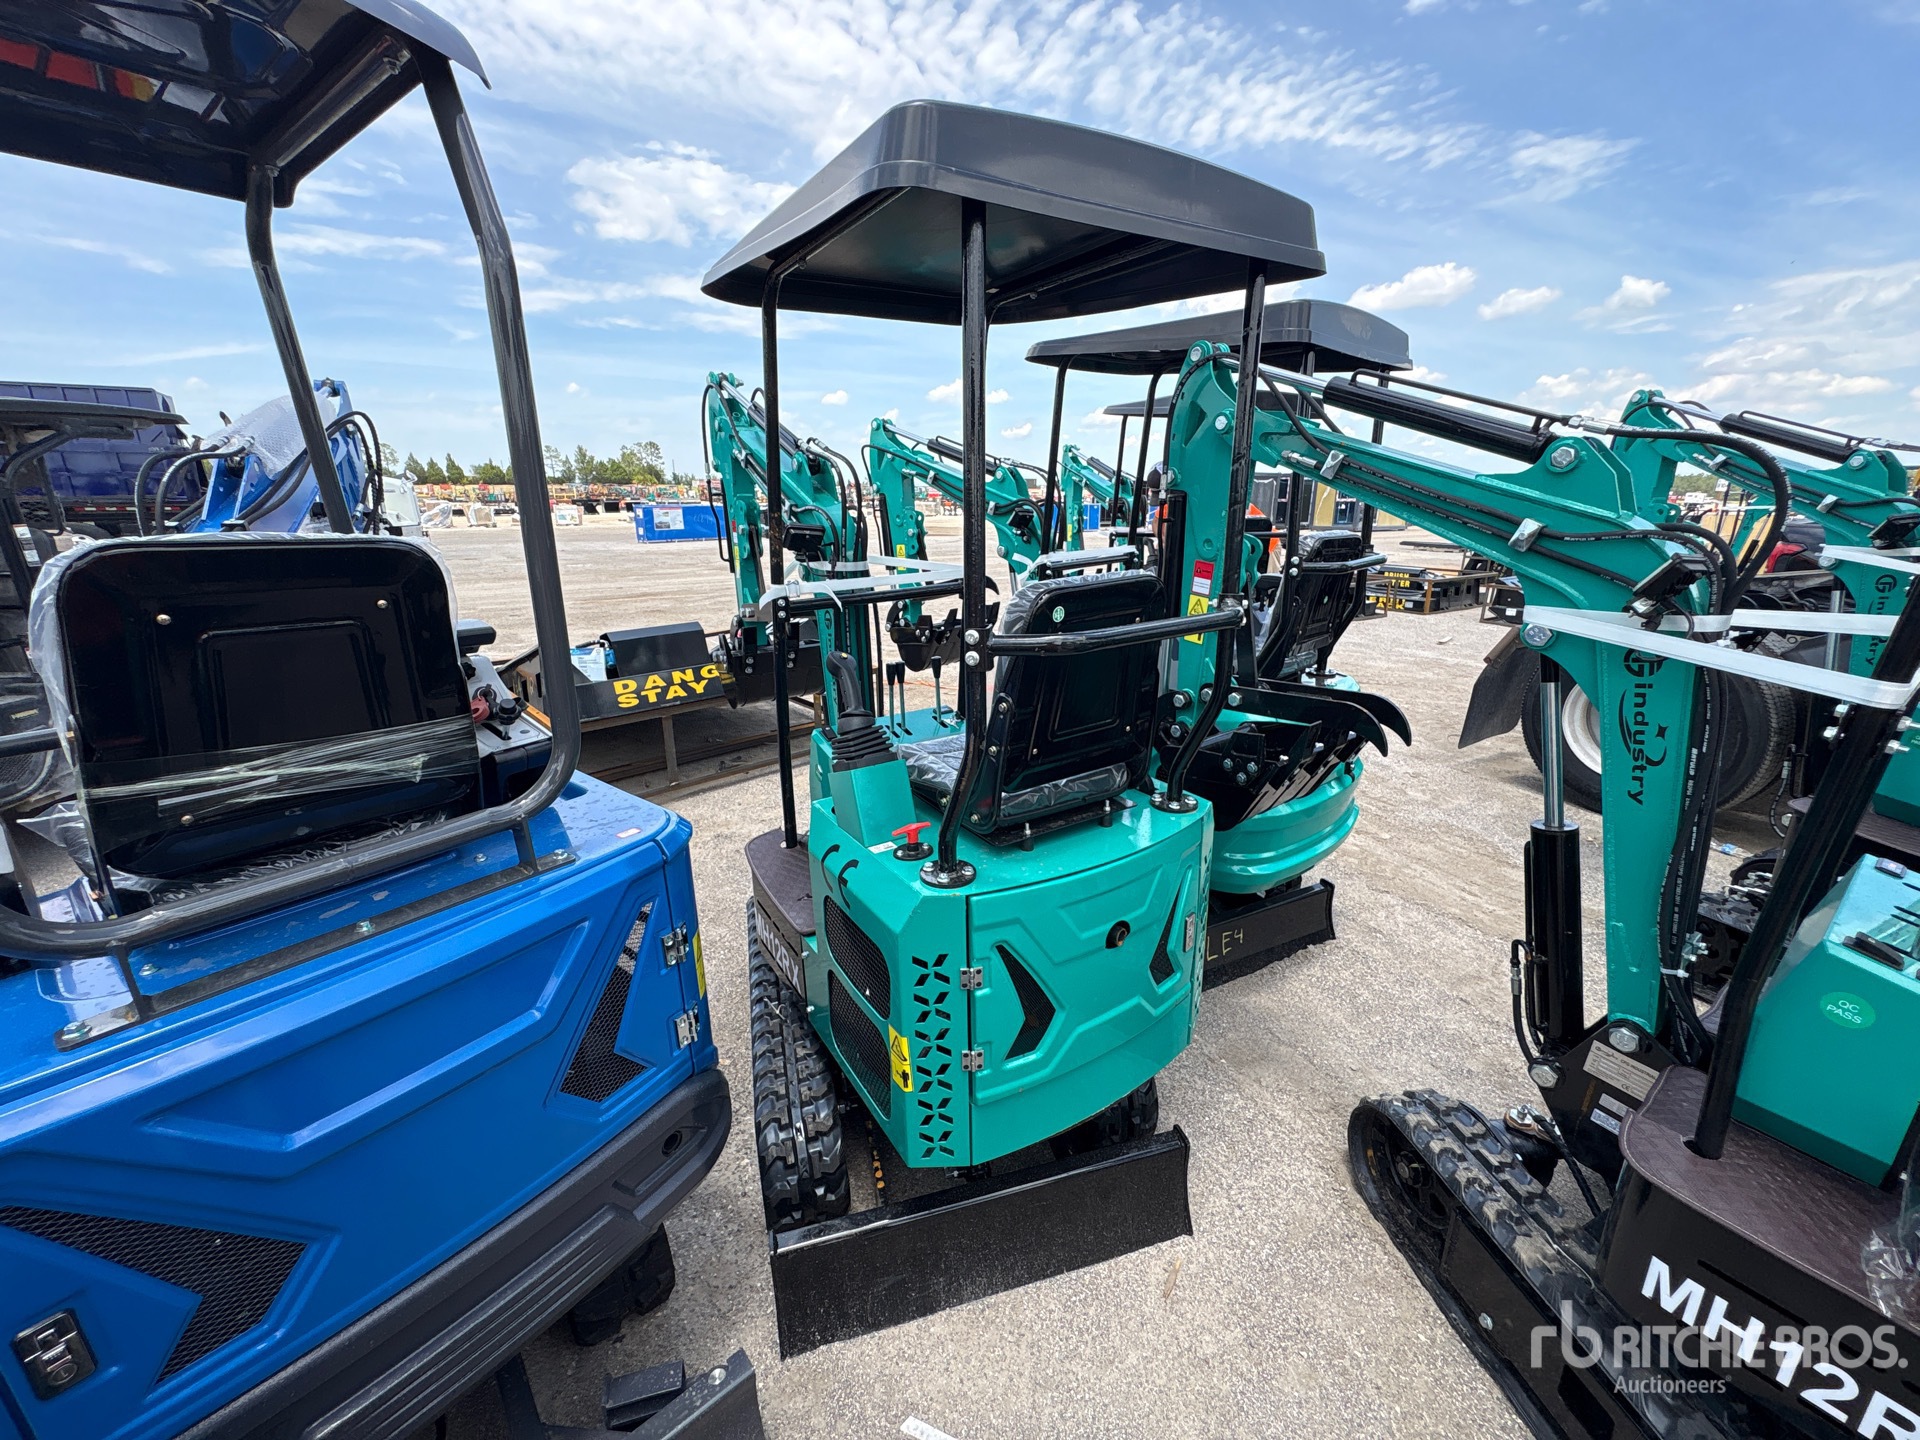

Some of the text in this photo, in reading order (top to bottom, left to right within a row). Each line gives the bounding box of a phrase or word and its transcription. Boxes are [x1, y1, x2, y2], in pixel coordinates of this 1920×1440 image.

[617, 679, 709, 708] STAY
[1826, 1004, 1862, 1024] PASS
[1838, 1000, 1860, 1012] QC
